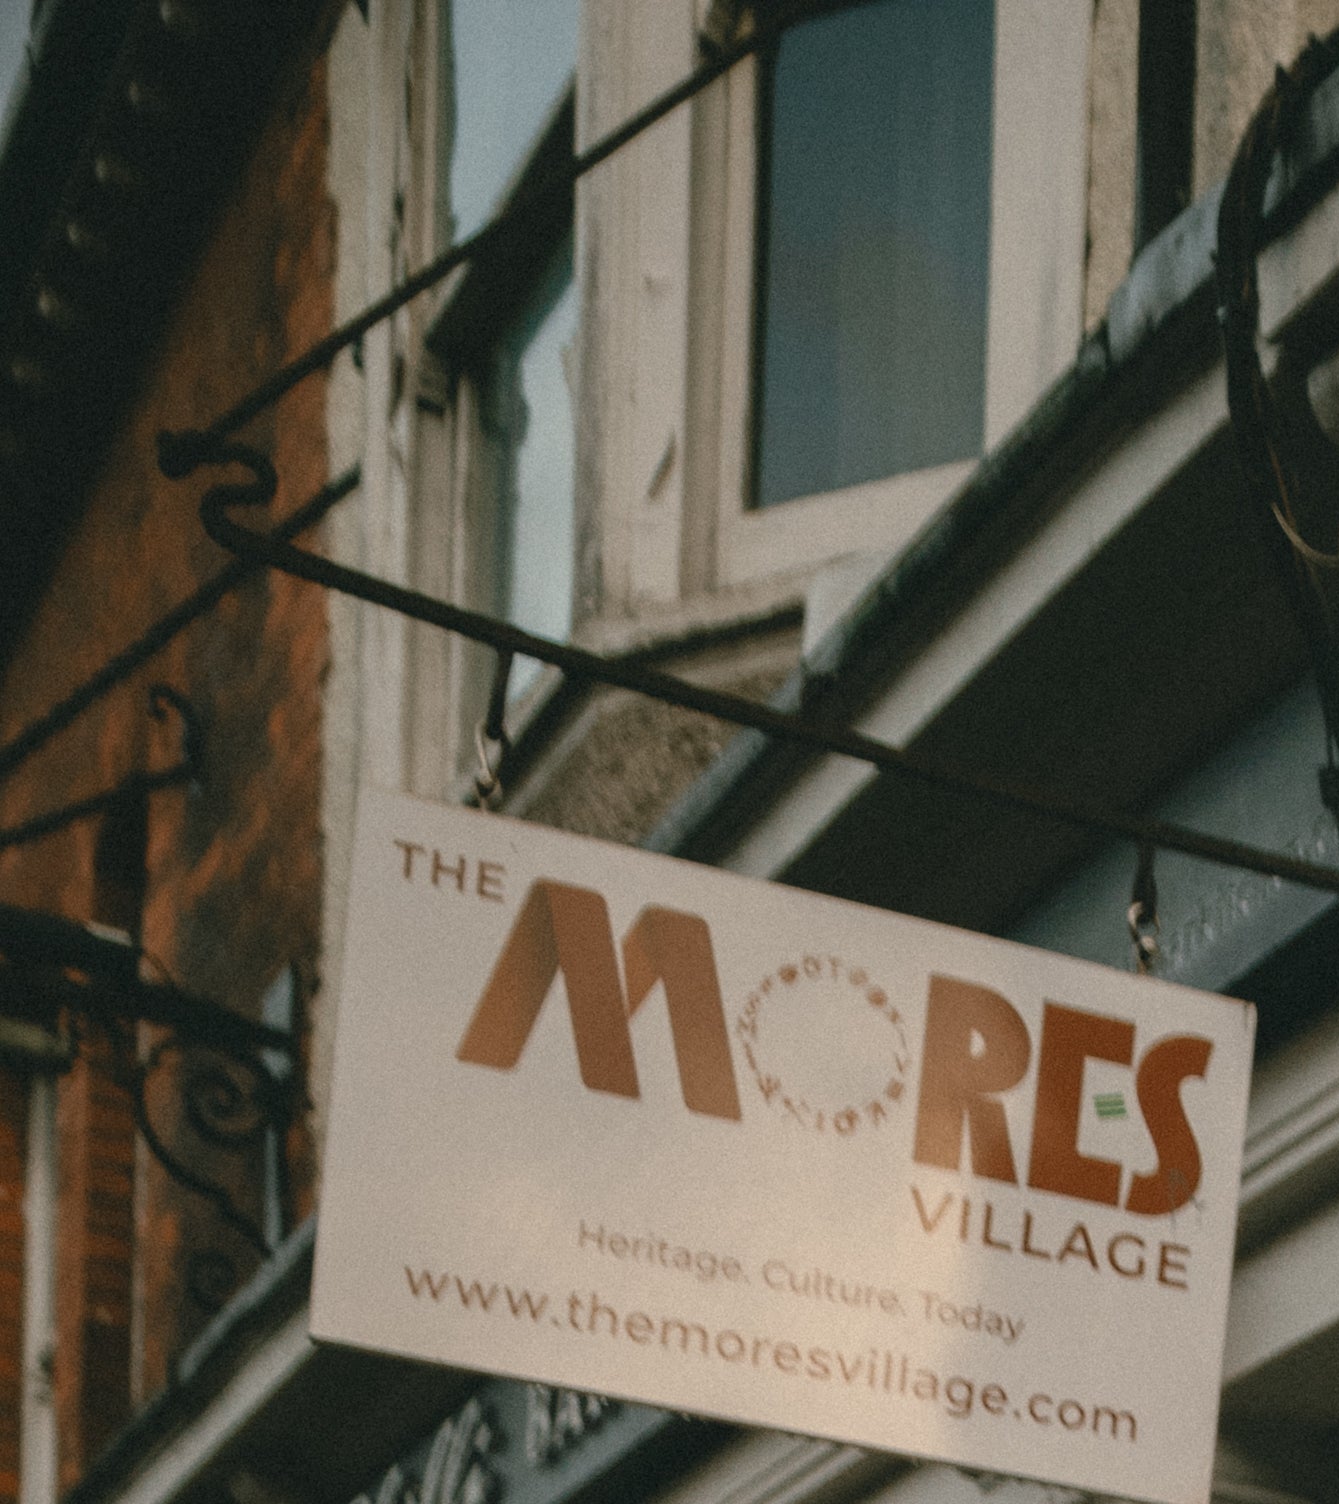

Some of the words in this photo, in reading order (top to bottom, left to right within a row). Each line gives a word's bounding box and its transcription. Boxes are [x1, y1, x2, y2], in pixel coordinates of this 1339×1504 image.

[392, 837, 508, 905] THE
[455, 875, 1215, 1219] MORES
[909, 1183, 1192, 1292] VILLAGE
[403, 1263, 1139, 1443] www.themoresvillage.com
[918, 1289, 1027, 1346] Today
